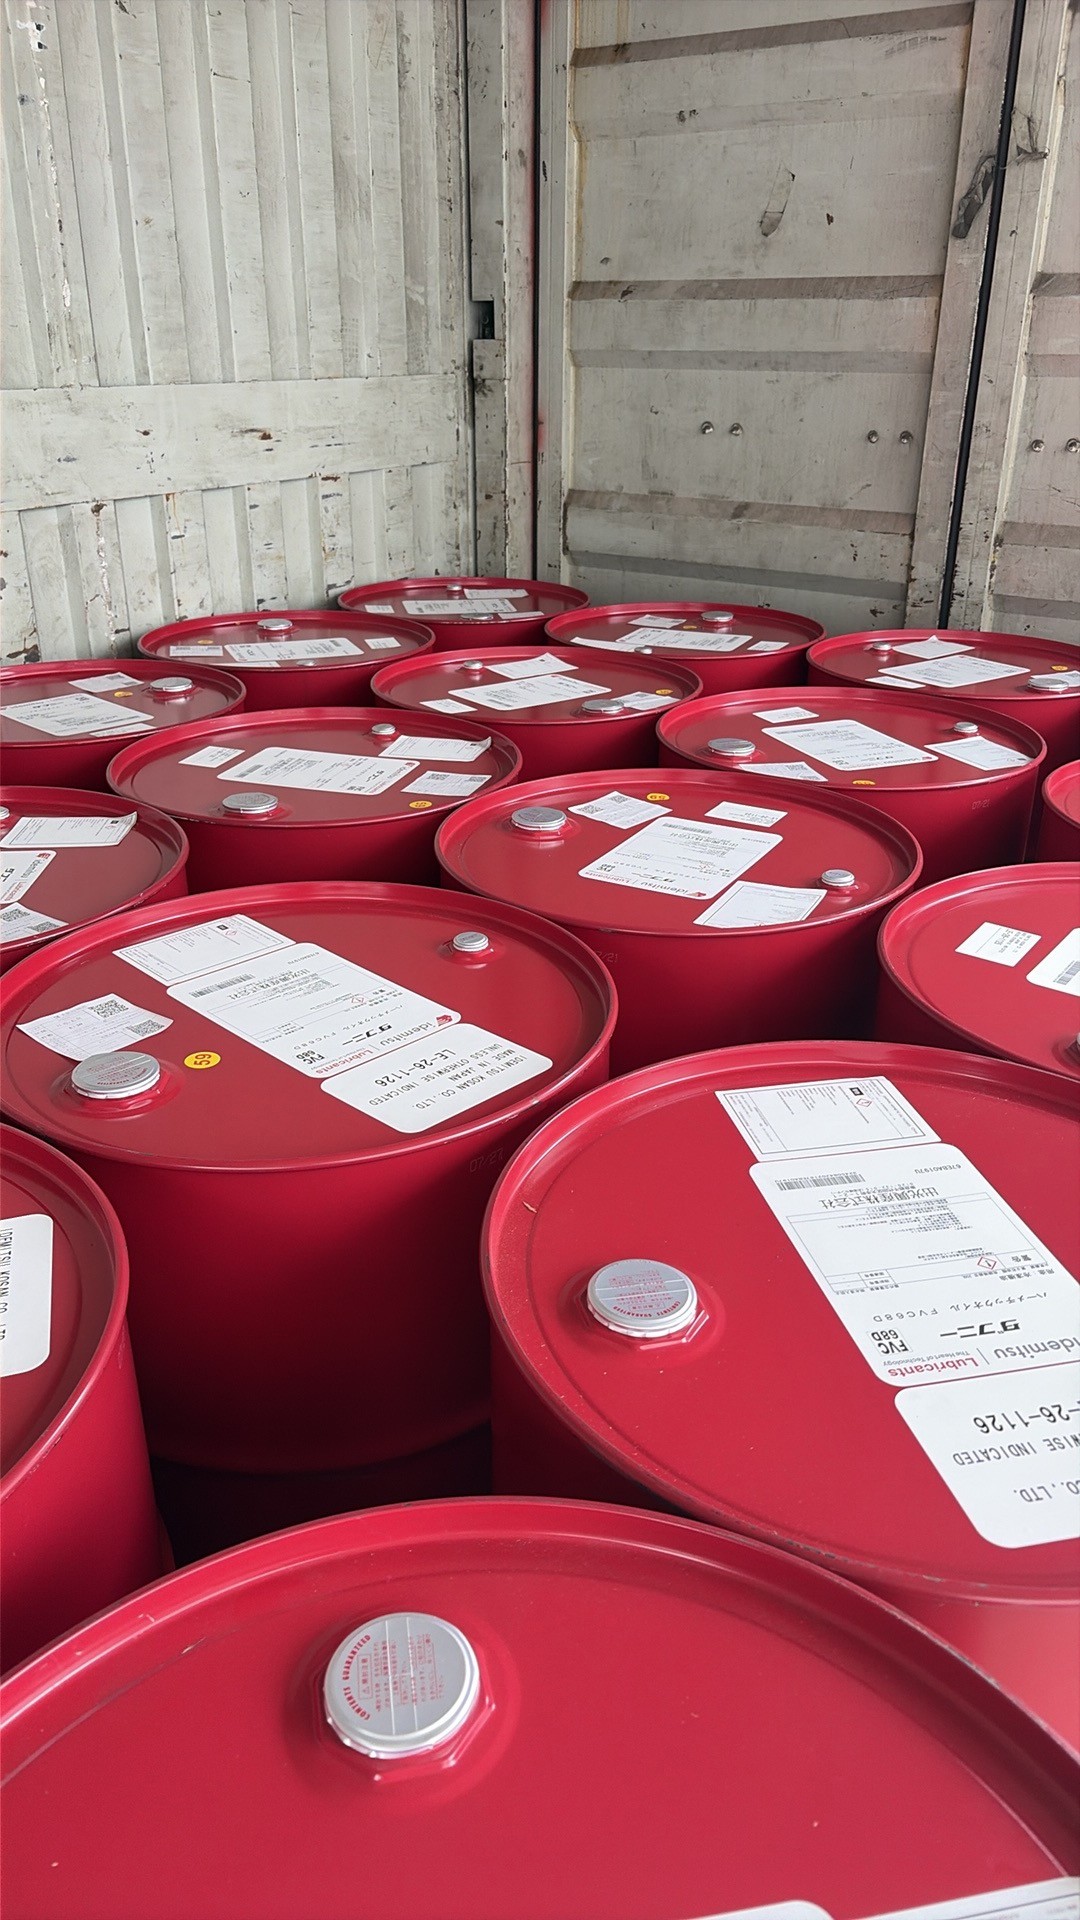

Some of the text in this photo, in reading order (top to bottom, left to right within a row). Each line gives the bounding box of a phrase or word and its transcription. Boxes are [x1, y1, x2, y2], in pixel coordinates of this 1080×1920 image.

[640, 881, 688, 894] idemitsu
[342, 1024, 392, 1045] ダフニー
[296, 1050, 315, 1059] 68D
[302, 1053, 325, 1064] FVC
[315, 1022, 435, 1074] idemitsu Lubricants
[491, 1049, 515, 1061] MADE
[194, 1054, 211, 1066] 59
[374, 1049, 455, 1086] LE-26-1126
[485, 1055, 527, 1076] IDEMITSU
[369, 1043, 502, 1105] UNLESS OTHERWISE INDICATED
[448, 1067, 475, 1081] JAPAN
[456, 1075, 485, 1090] KOSAN
[820, 1187, 938, 1208] 出光興産株式会社
[873, 1292, 1046, 1322] ハーメチックオイル FVC68D
[871, 1329, 898, 1341] 68D
[940, 1319, 1020, 1338] ダフニー
[877, 1339, 908, 1354] FVC
[888, 1337, 1080, 1376] idemitsu Lubricants
[883, 1357, 926, 1366] Technology
[973, 1401, 1080, 1433] -26-1126
[952, 1434, 1080, 1465] WISE INDICATED
[342, 1634, 371, 1681] GUARANTEED
[343, 1686, 371, 1721] CONTENTS
